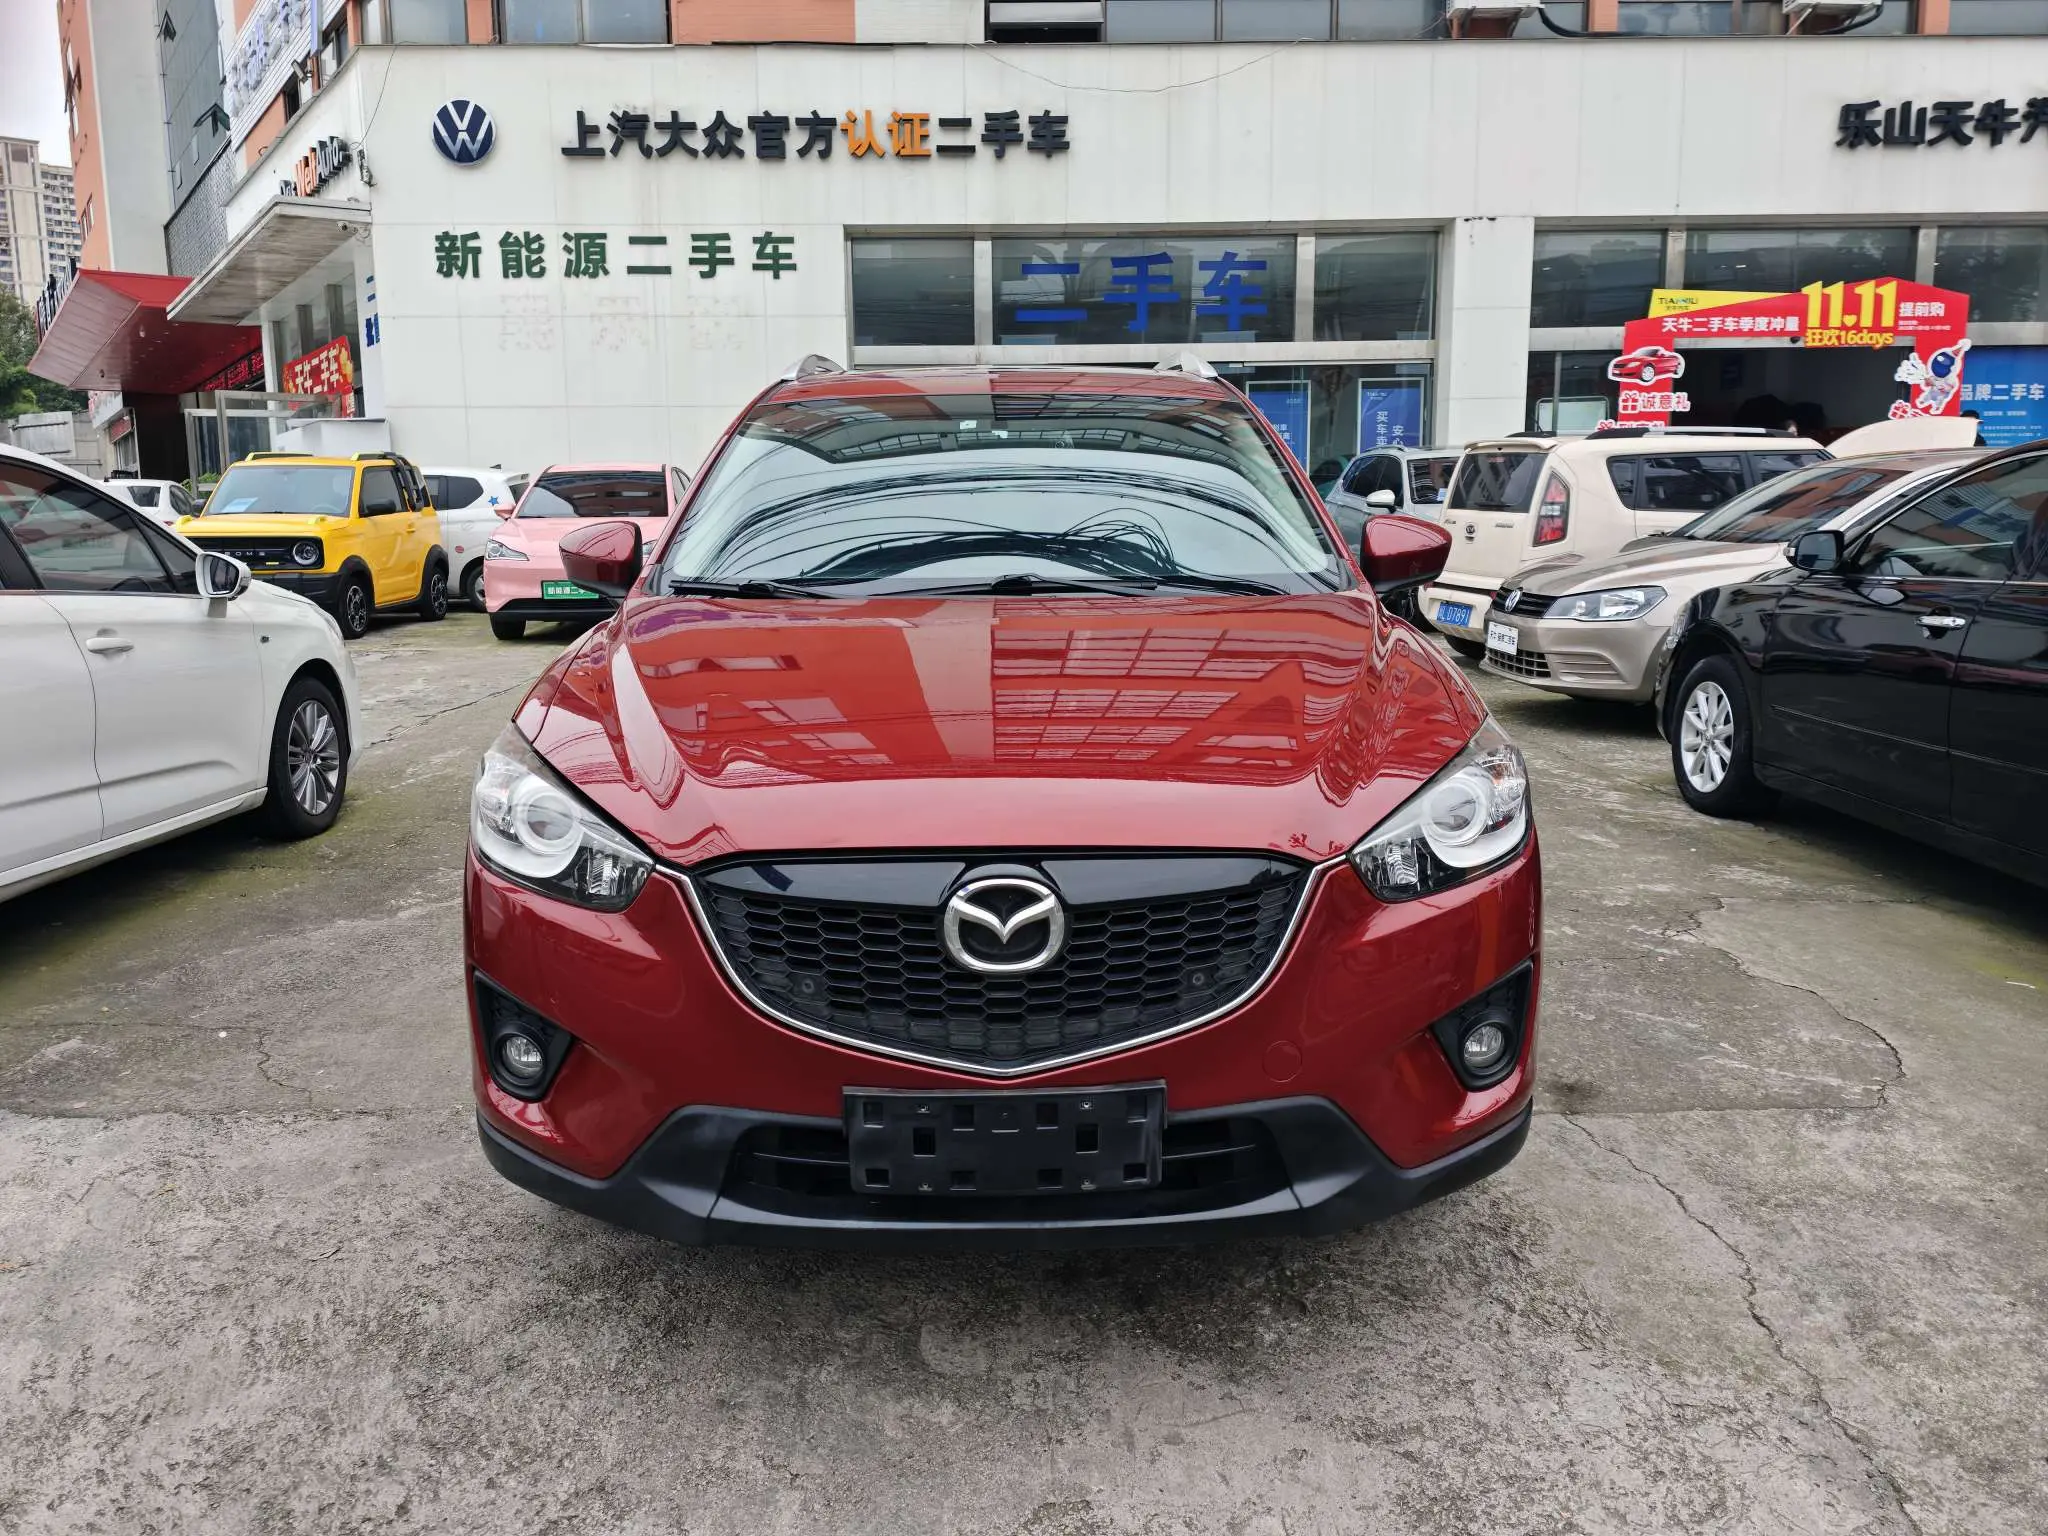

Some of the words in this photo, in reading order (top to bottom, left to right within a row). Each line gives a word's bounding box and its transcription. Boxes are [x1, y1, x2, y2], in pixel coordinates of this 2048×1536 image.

[561, 110, 1070, 159] 上汽大众官方认证二手车
[434, 230, 798, 280] 新能源二手车
[1015, 250, 1268, 333] 二手车
[1899, 302, 1945, 317] 提前购
[1662, 316, 1800, 332] 天牛二手车季度冲量
